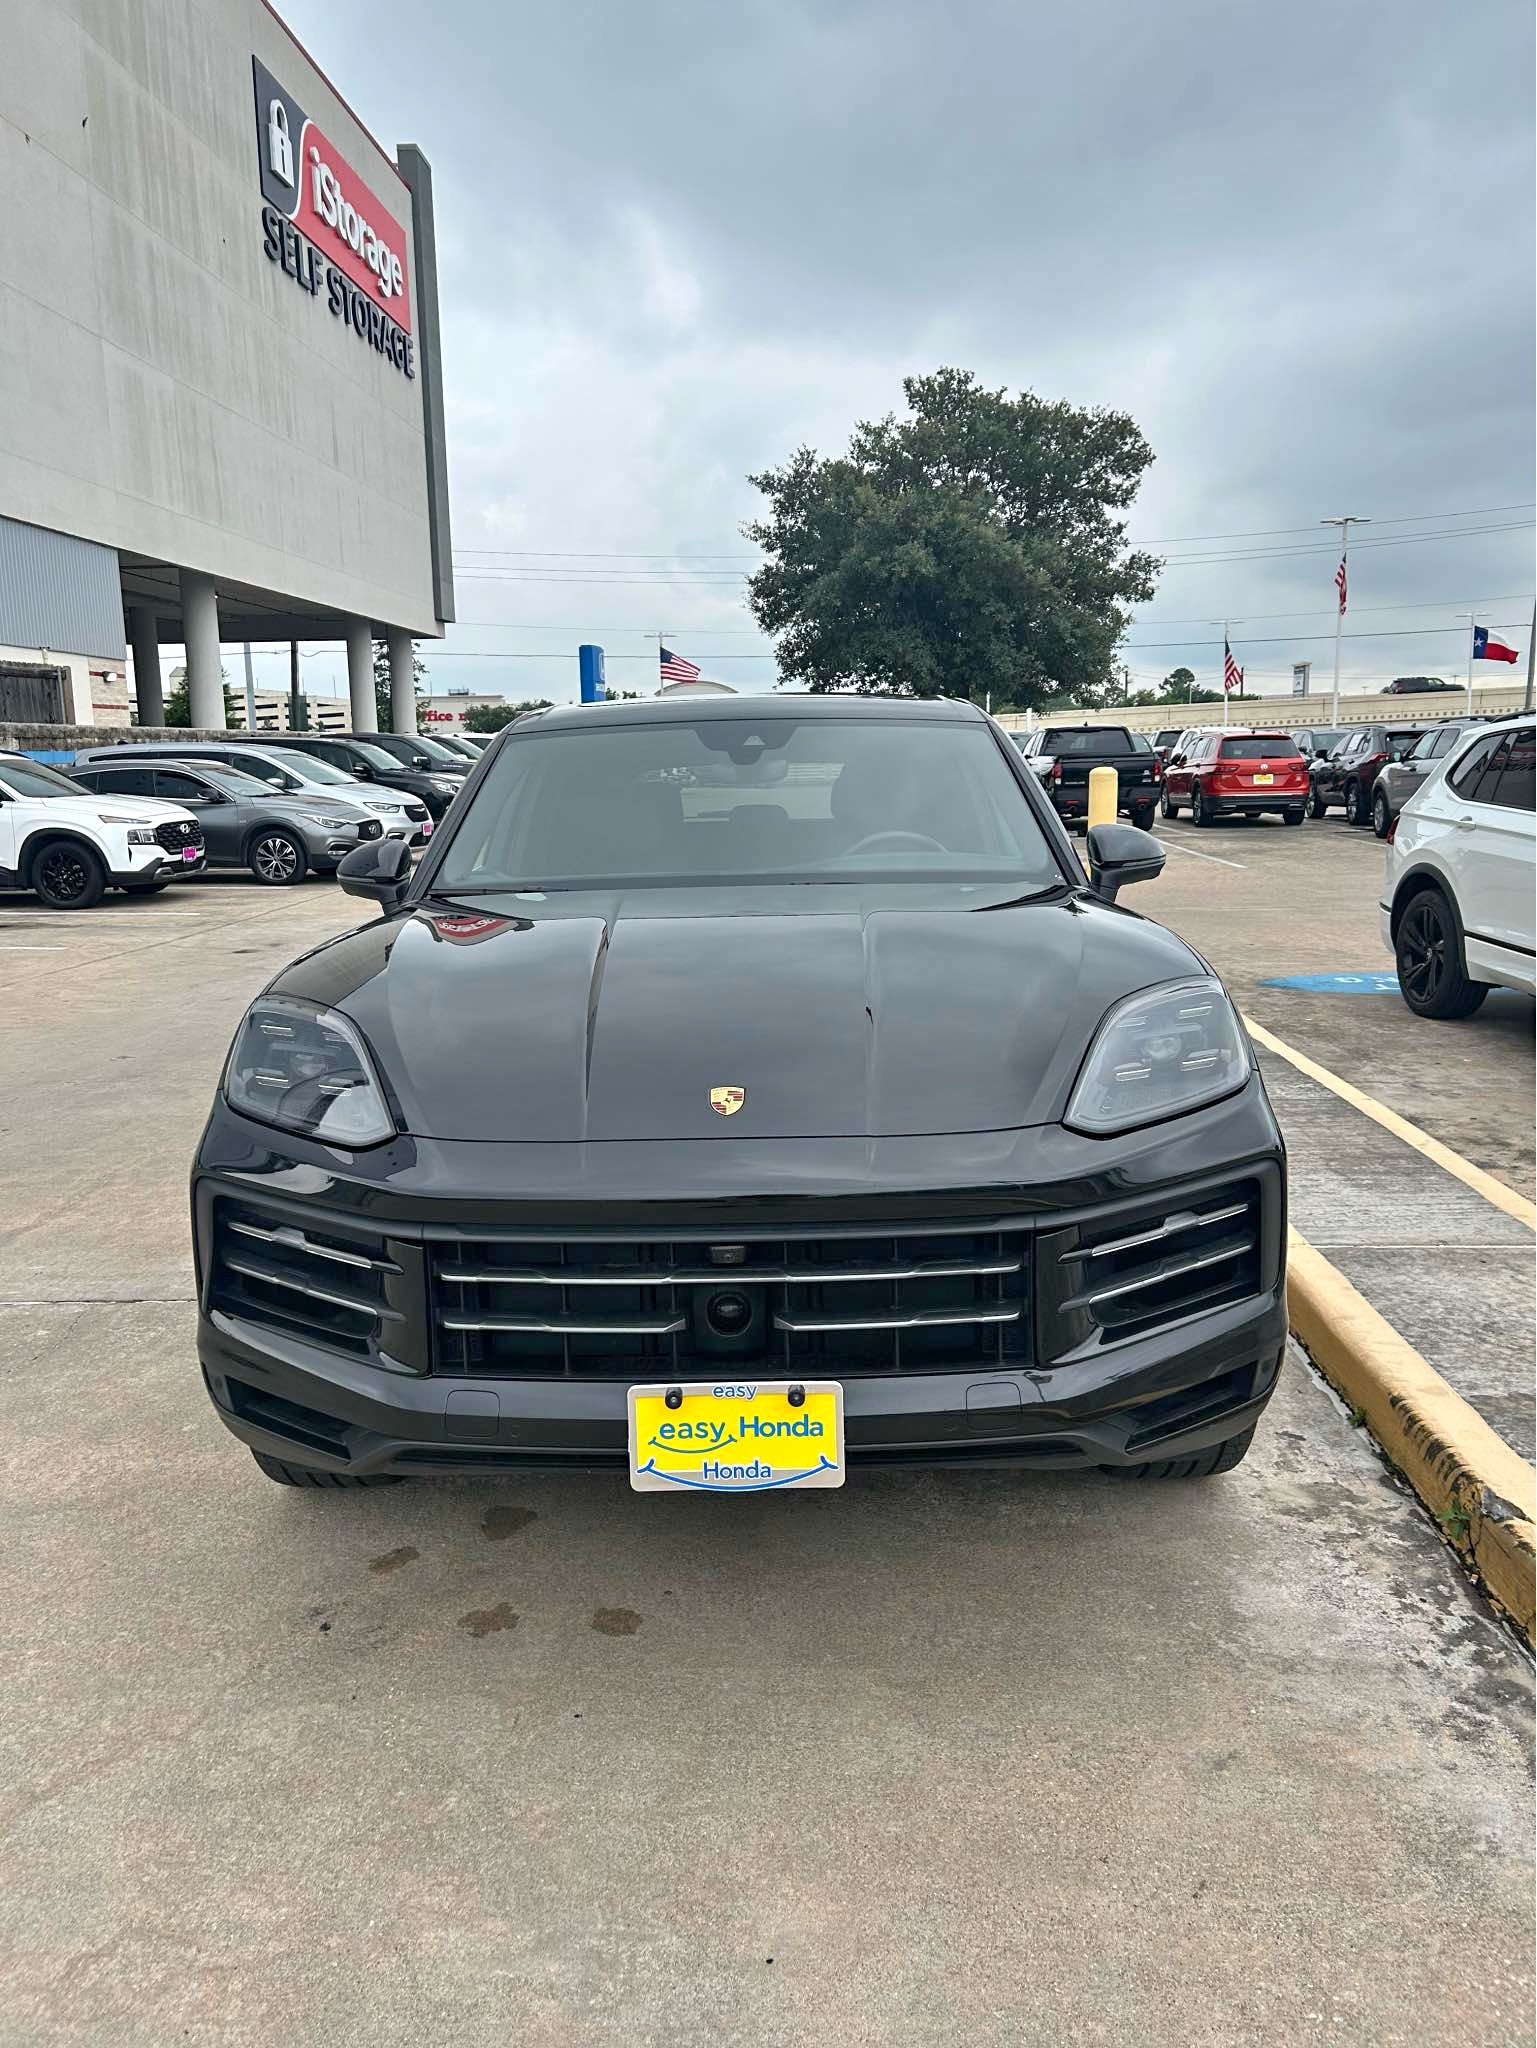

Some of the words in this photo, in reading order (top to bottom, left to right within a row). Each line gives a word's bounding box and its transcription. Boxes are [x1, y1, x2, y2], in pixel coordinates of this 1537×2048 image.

[309, 146, 403, 298] iStorage
[262, 206, 323, 295] SELF
[327, 267, 415, 379] STORAGE
[713, 1385, 757, 1399] easy
[660, 1421, 726, 1442] easy
[740, 1414, 824, 1437] Honda
[703, 1460, 772, 1479] Honda
